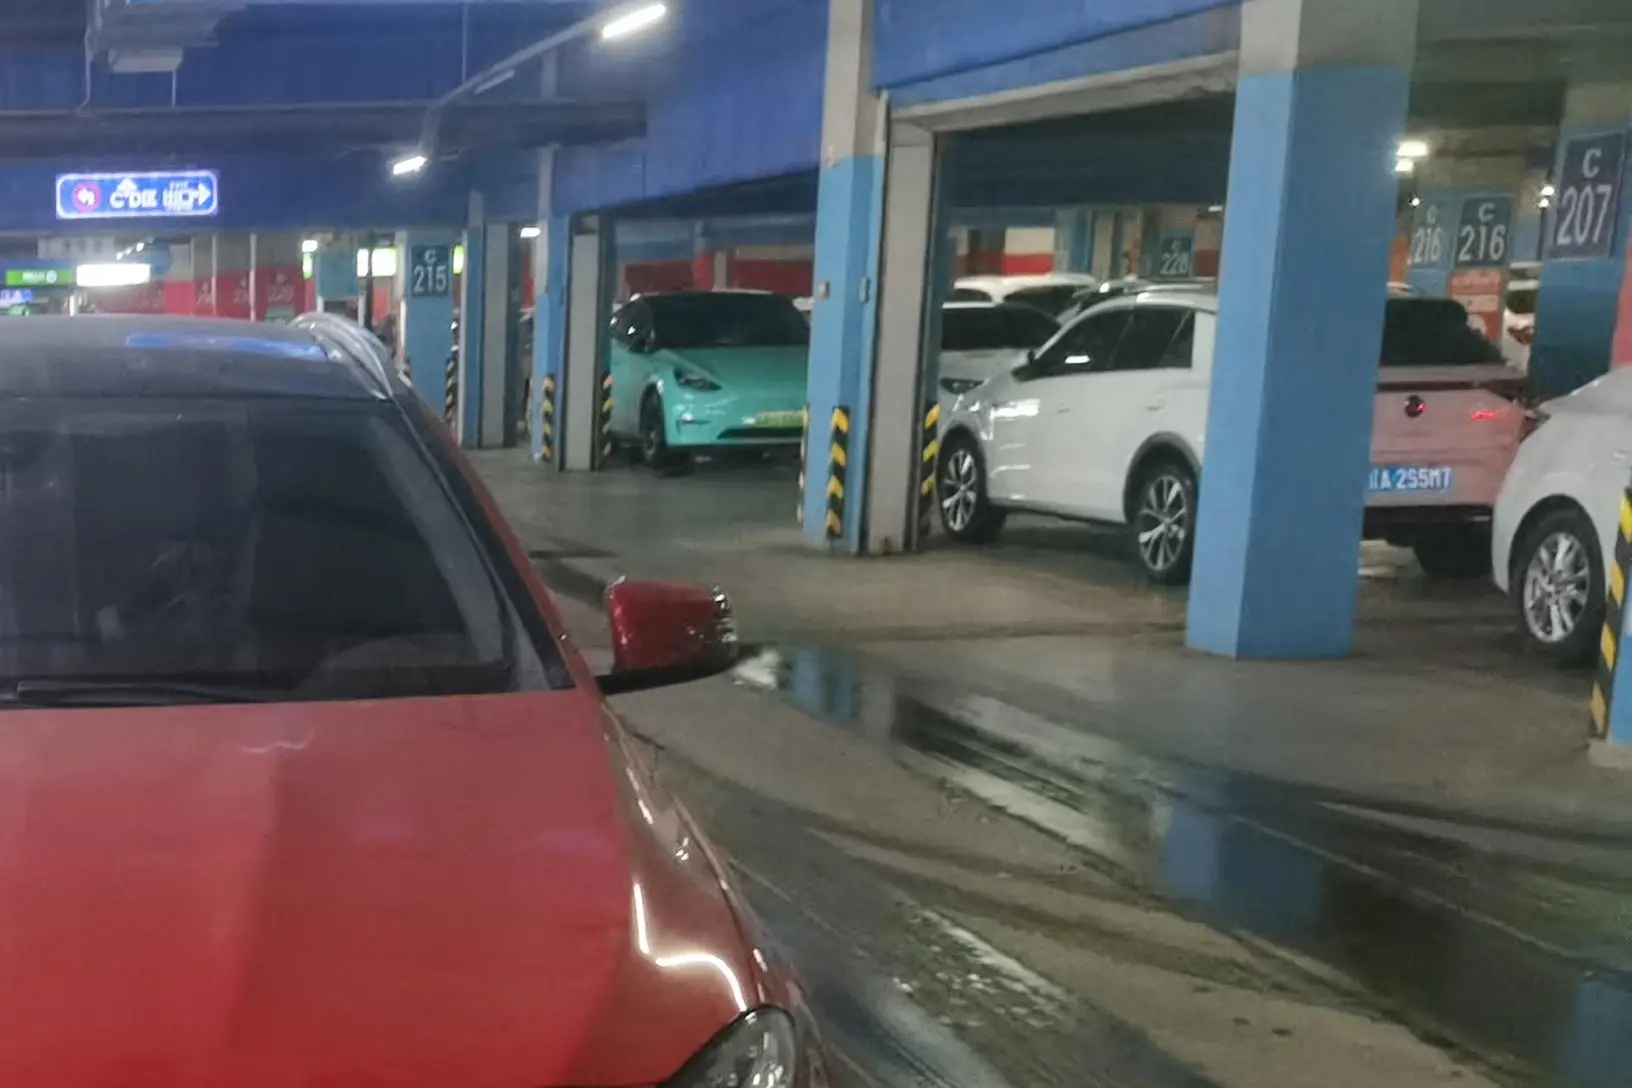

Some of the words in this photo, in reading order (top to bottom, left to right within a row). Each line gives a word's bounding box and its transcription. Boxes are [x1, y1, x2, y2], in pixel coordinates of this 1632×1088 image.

[1581, 147, 1602, 179] C
[1478, 203, 1495, 222] C
[1555, 184, 1612, 247] 207
[424, 249, 438, 264] C
[1458, 224, 1506, 262] 216
[413, 264, 447, 292] 215
